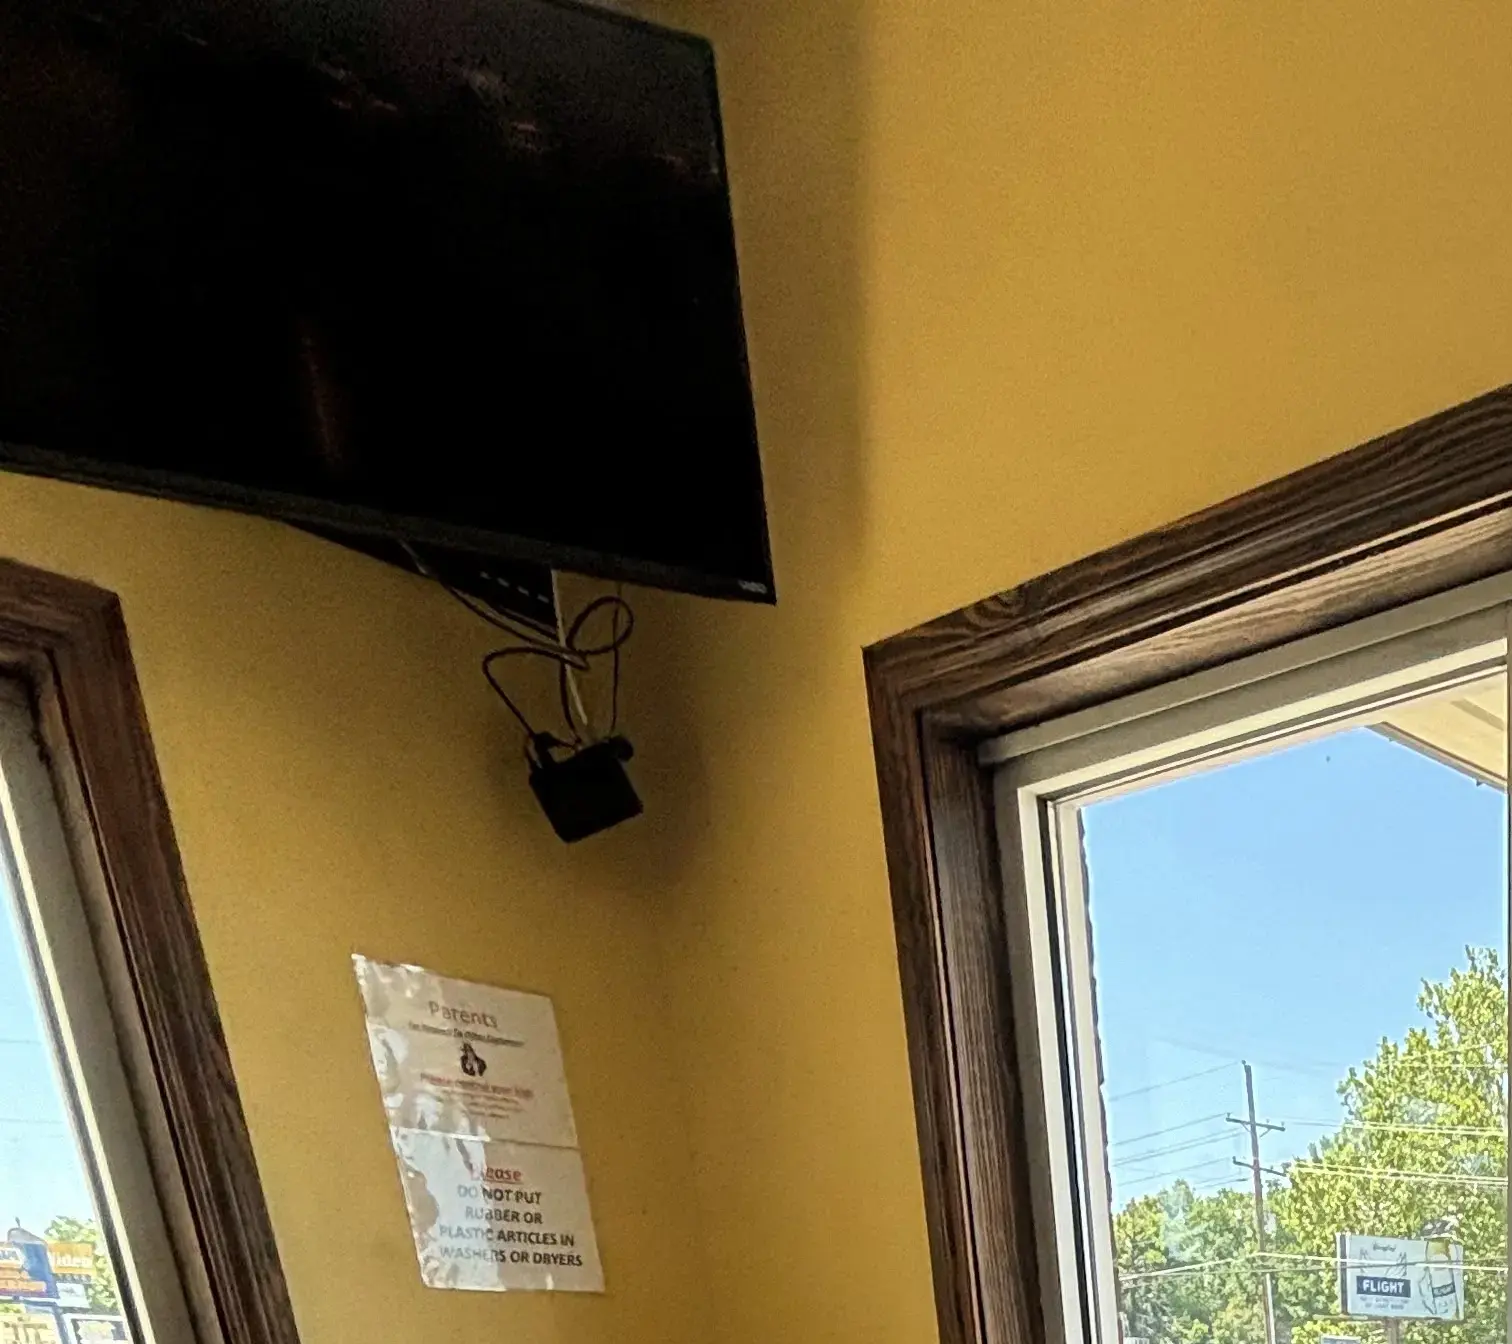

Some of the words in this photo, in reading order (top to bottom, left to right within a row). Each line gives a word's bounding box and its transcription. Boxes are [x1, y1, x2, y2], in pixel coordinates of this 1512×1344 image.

[428, 1000, 498, 1027] Parents
[457, 1184, 477, 1198] DO
[482, 1187, 513, 1202] NOT
[514, 1190, 542, 1205] PUT
[466, 1206, 520, 1222] RUBBER
[523, 1211, 543, 1224] OR
[439, 1225, 495, 1241] PLASTIC
[496, 1230, 557, 1245] ARTICLES
[560, 1234, 575, 1246] IN
[440, 1246, 506, 1263] WASHERS
[510, 1251, 530, 1263] OR
[532, 1253, 583, 1267] DRYERS
[1363, 1279, 1404, 1294] FLIGHT
